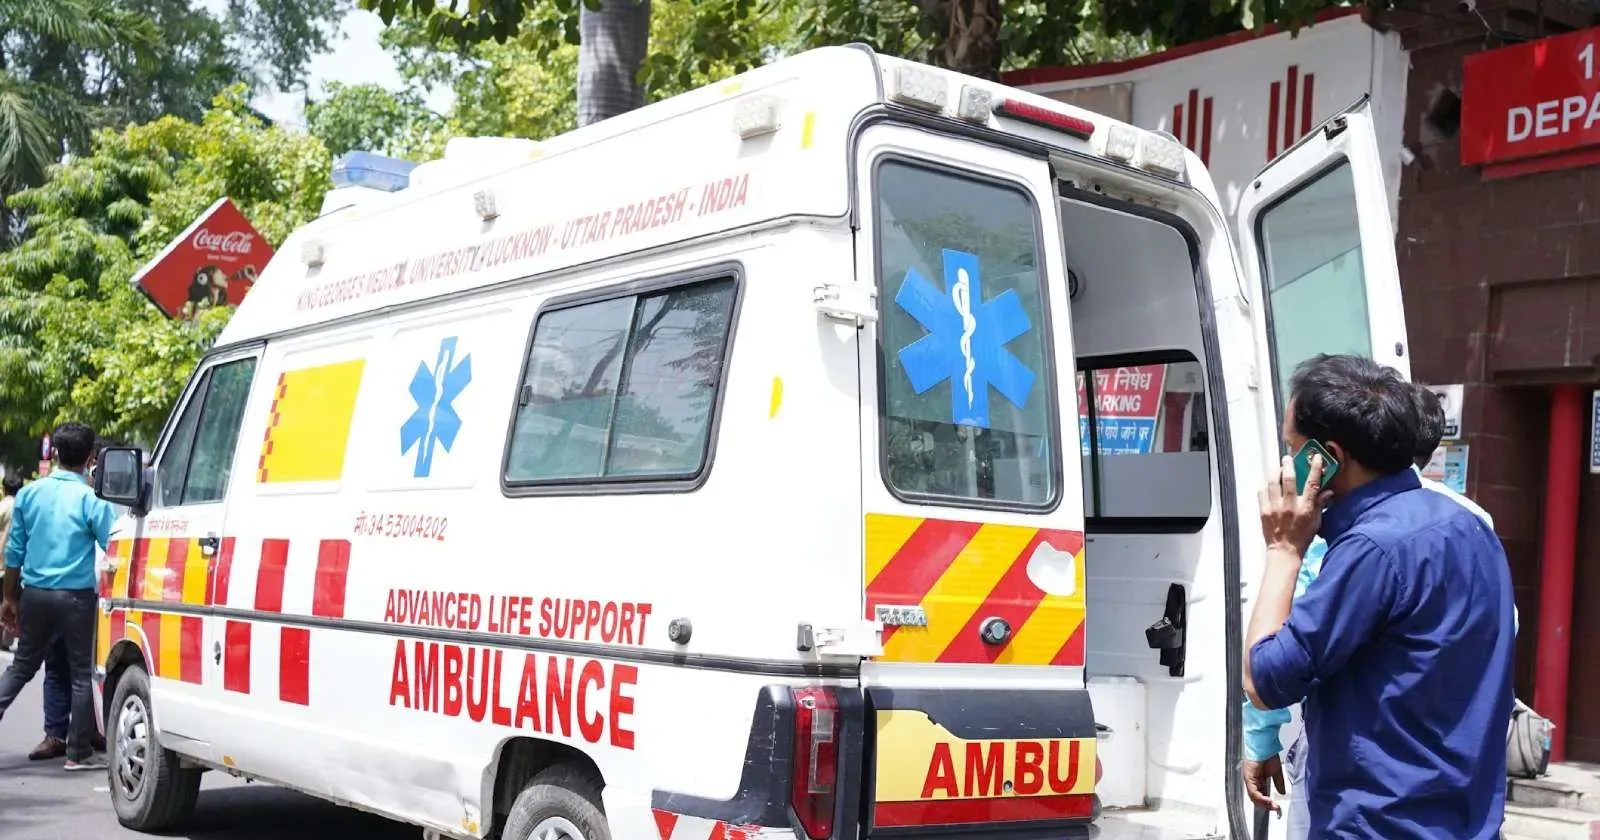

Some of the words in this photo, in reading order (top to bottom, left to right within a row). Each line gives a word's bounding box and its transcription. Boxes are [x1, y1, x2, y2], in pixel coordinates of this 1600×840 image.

[485, 225, 554, 268] LUCKNOW
[560, 213, 611, 251] UTTAR
[609, 189, 688, 239] PRADESH
[697, 172, 749, 217] INDIA
[1095, 394, 1142, 412] ARKING
[384, 588, 482, 630] ADVANCED
[487, 595, 534, 635] LIFE
[538, 596, 652, 646] SUPPORT
[389, 638, 638, 751] AMBULANCE
[920, 740, 1080, 799] AMBU
